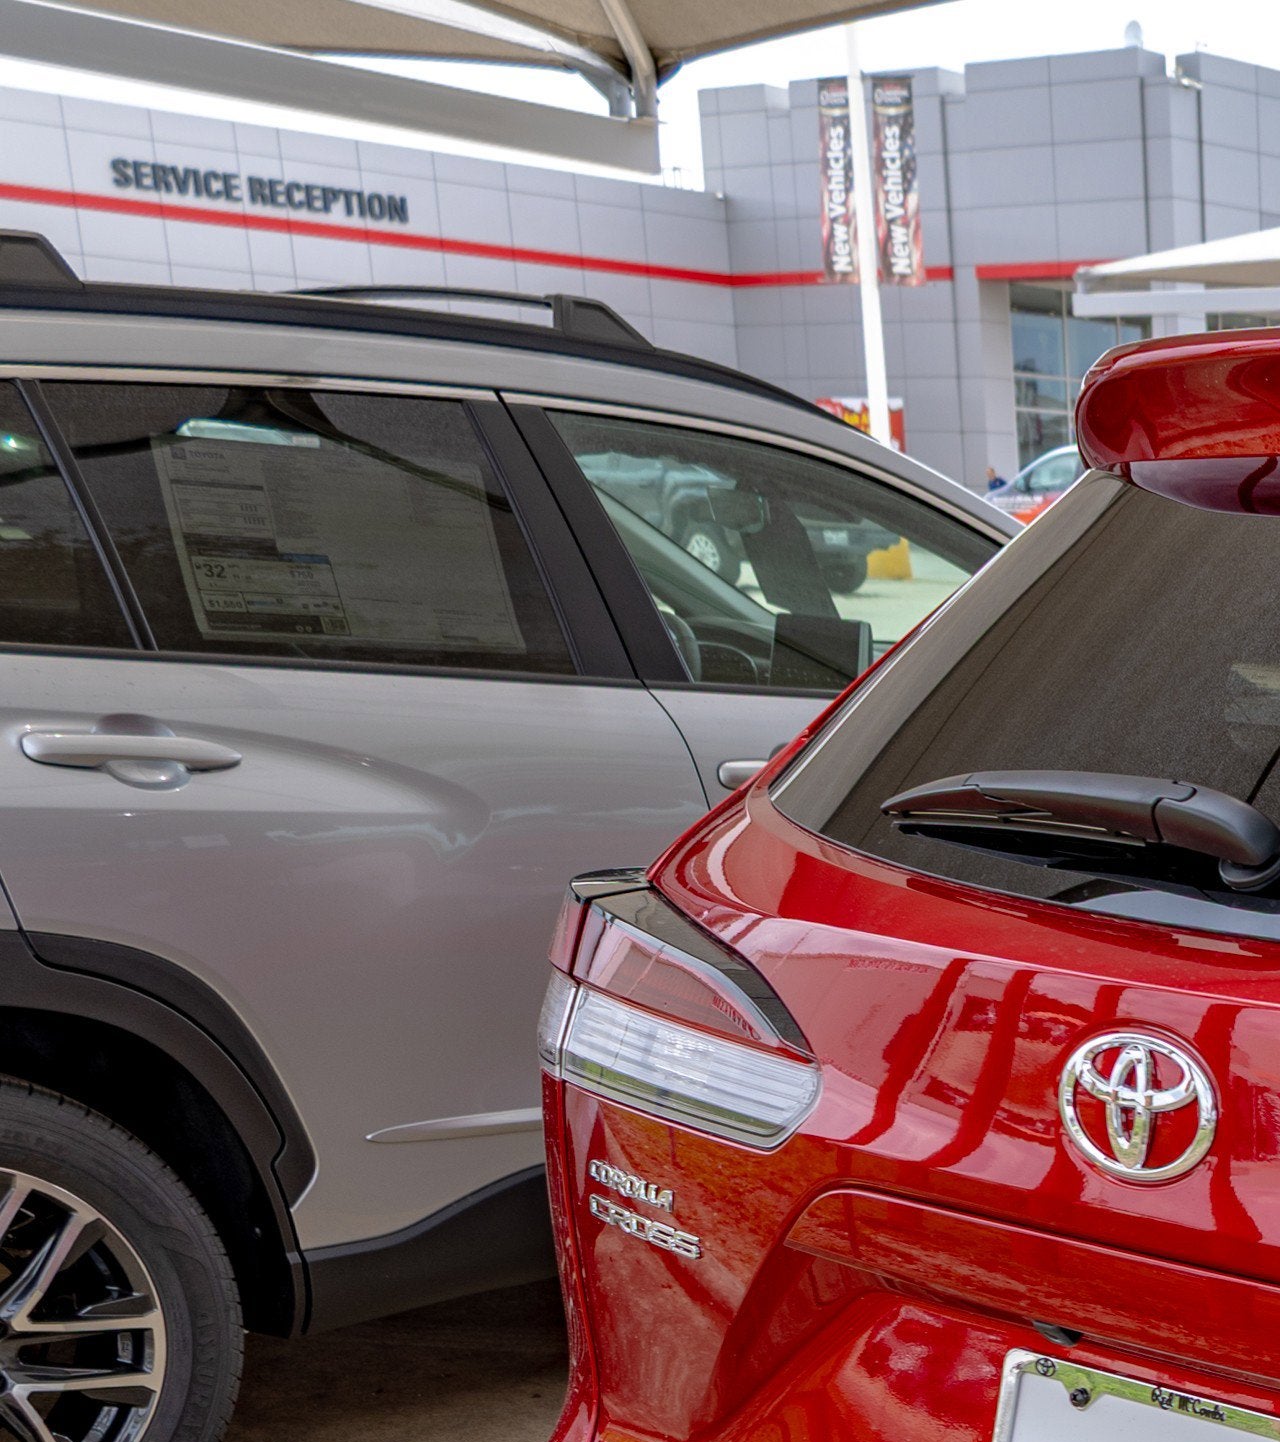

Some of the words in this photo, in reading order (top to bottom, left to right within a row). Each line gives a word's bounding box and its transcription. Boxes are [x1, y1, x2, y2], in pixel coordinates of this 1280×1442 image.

[110, 157, 243, 202] SERVICE
[248, 175, 410, 224] RECEPTION
[827, 125, 847, 219] Vehicles
[882, 124, 905, 221] Vehicles
[833, 223, 853, 273] New
[890, 224, 912, 275] New
[189, 449, 226, 460] TOYOTA
[203, 563, 227, 579] 32
[589, 1159, 675, 1212] COROLLA
[589, 1193, 703, 1260] CROSS
[1151, 1386, 1174, 1411] Red
[1174, 1393, 1226, 1421] McCombs
